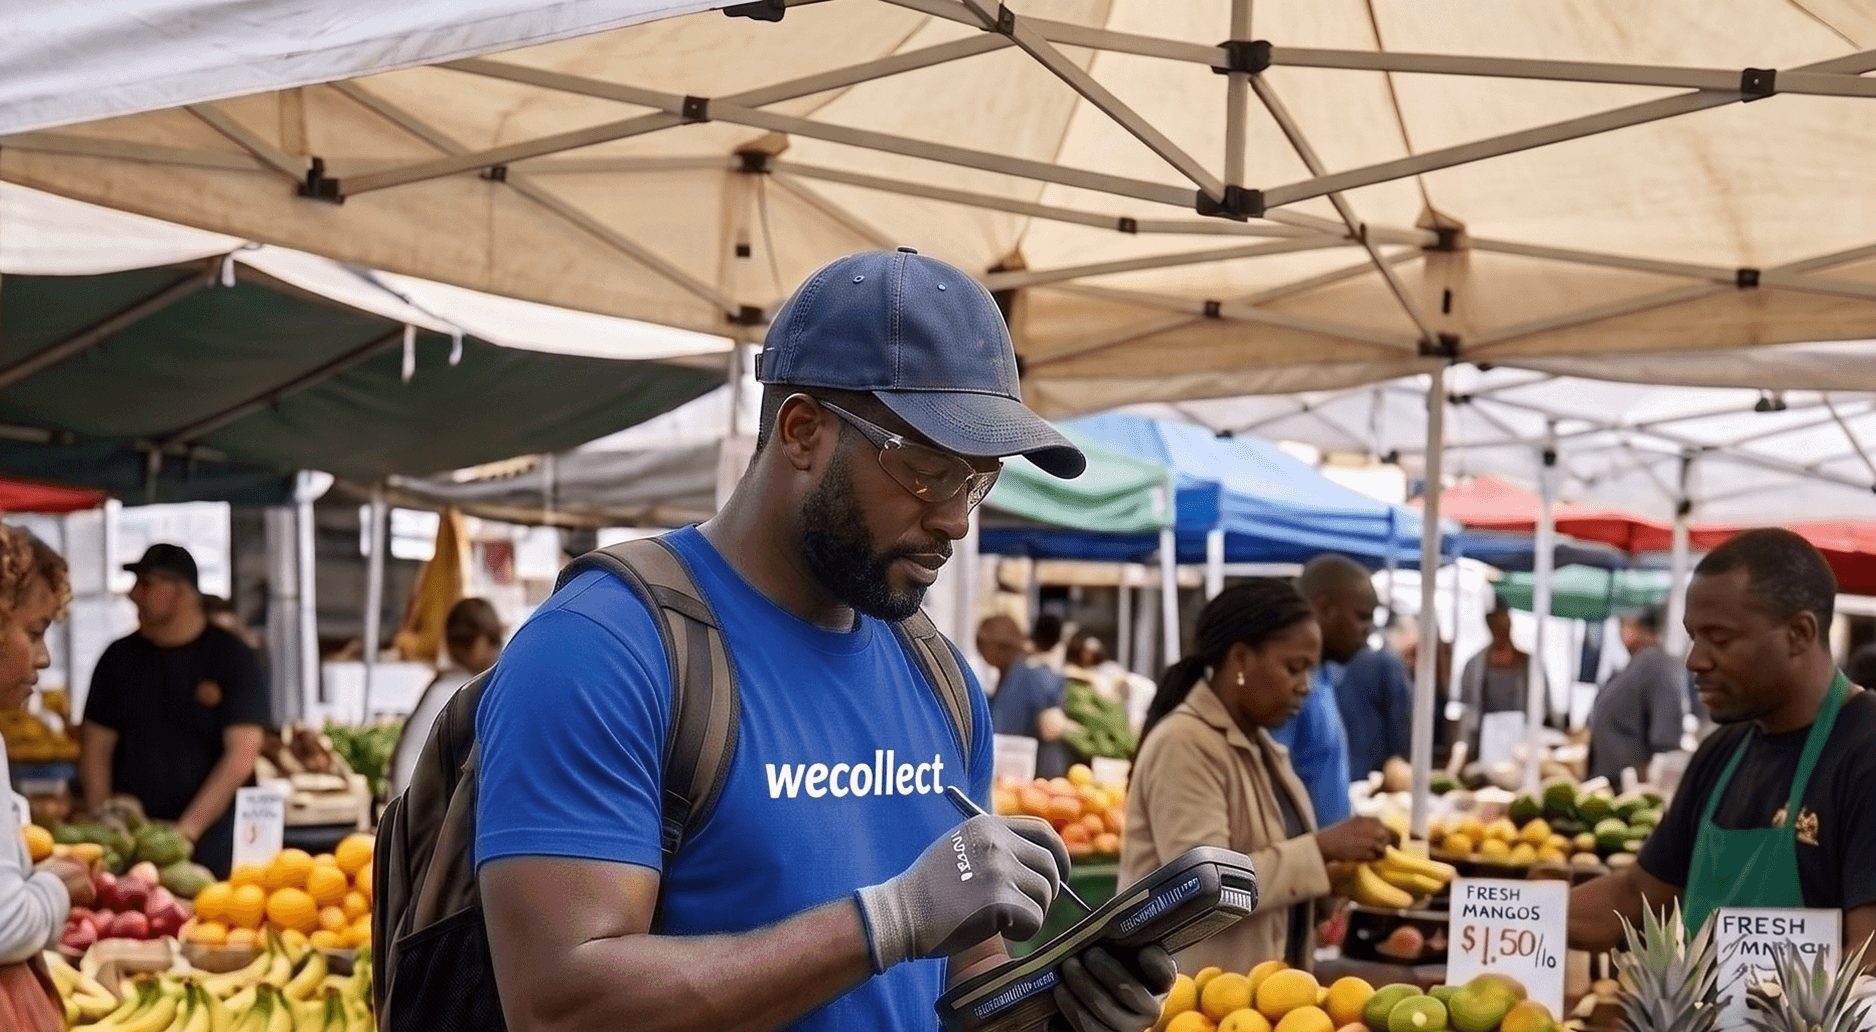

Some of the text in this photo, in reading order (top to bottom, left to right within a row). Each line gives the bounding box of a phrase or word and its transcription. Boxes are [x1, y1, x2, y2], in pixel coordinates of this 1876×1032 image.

[765, 749, 944, 799] wecollect
[1467, 885, 1520, 901] FRESH
[1462, 904, 1541, 921] MANGOS
[1723, 916, 1805, 935] FRESH
